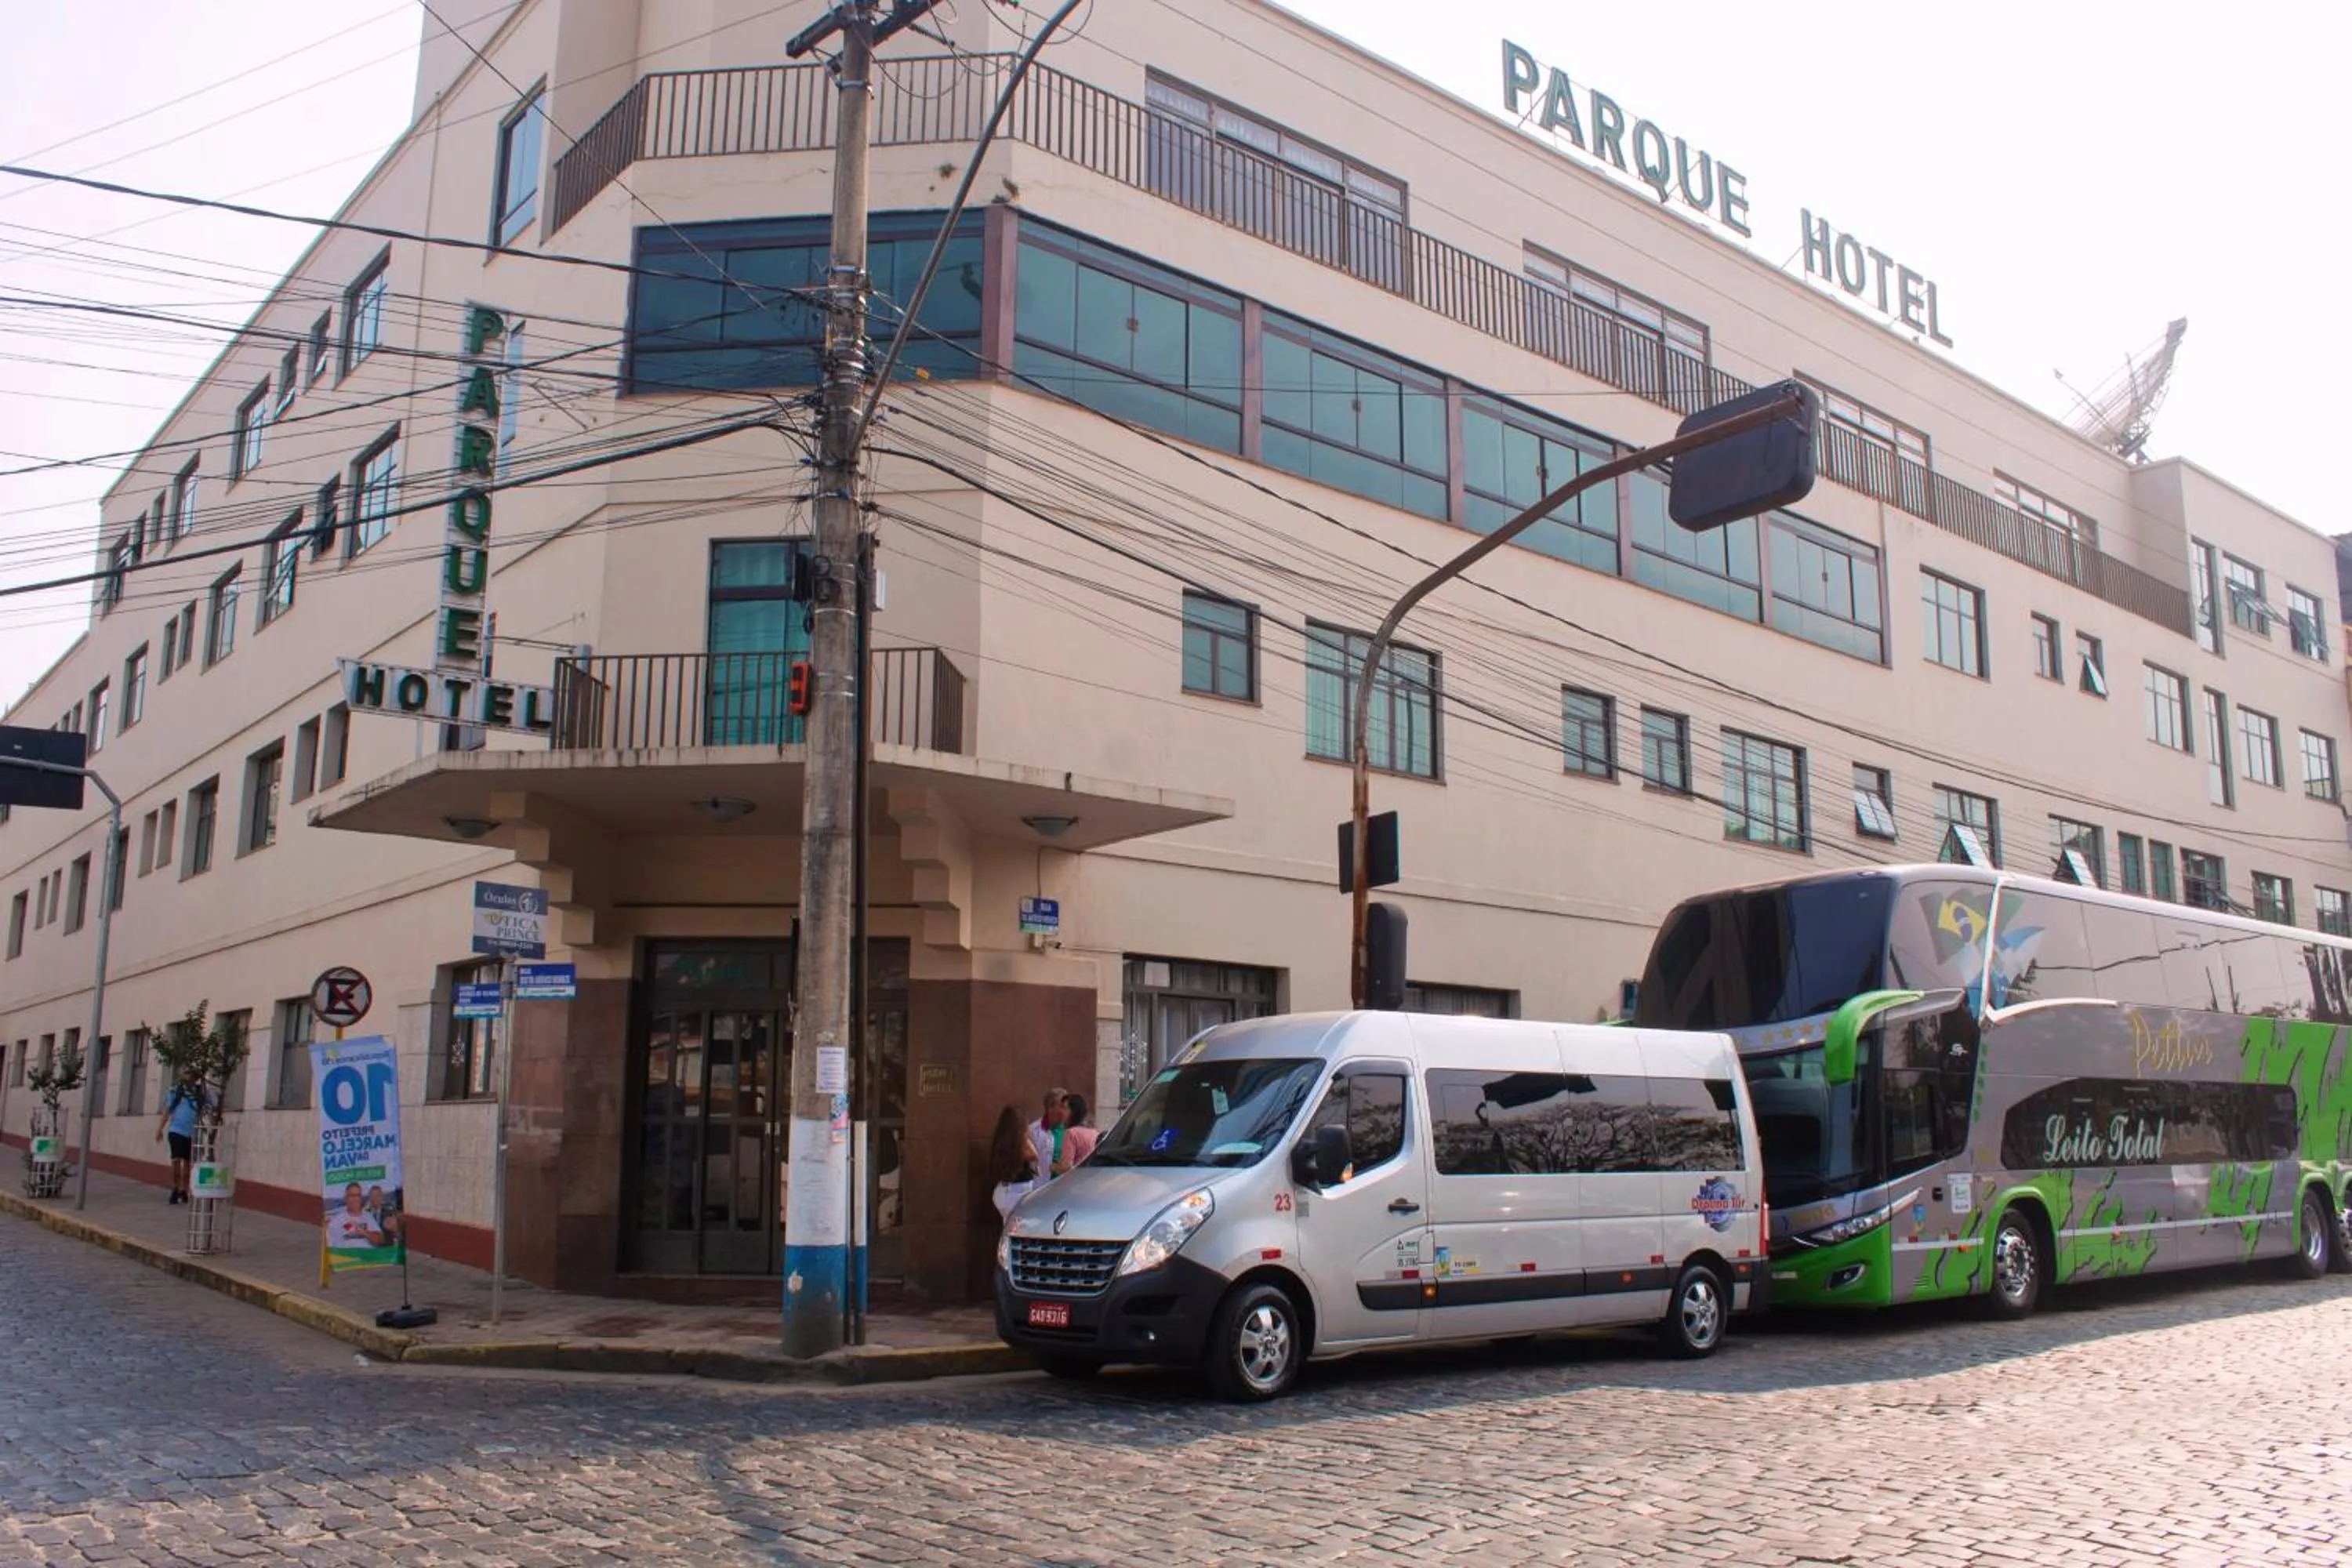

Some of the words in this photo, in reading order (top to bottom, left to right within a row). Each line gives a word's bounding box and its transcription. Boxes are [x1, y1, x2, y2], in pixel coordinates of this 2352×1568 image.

[1501, 38, 1751, 238] PARQUE
[1801, 207, 1953, 348] HOTEL
[444, 307, 504, 659] PARQUE
[355, 666, 550, 728] HOTEL
[2042, 1112, 2105, 1162] Leito
[2107, 1114, 2165, 1160] Total
[1274, 1192, 1292, 1211] 23
